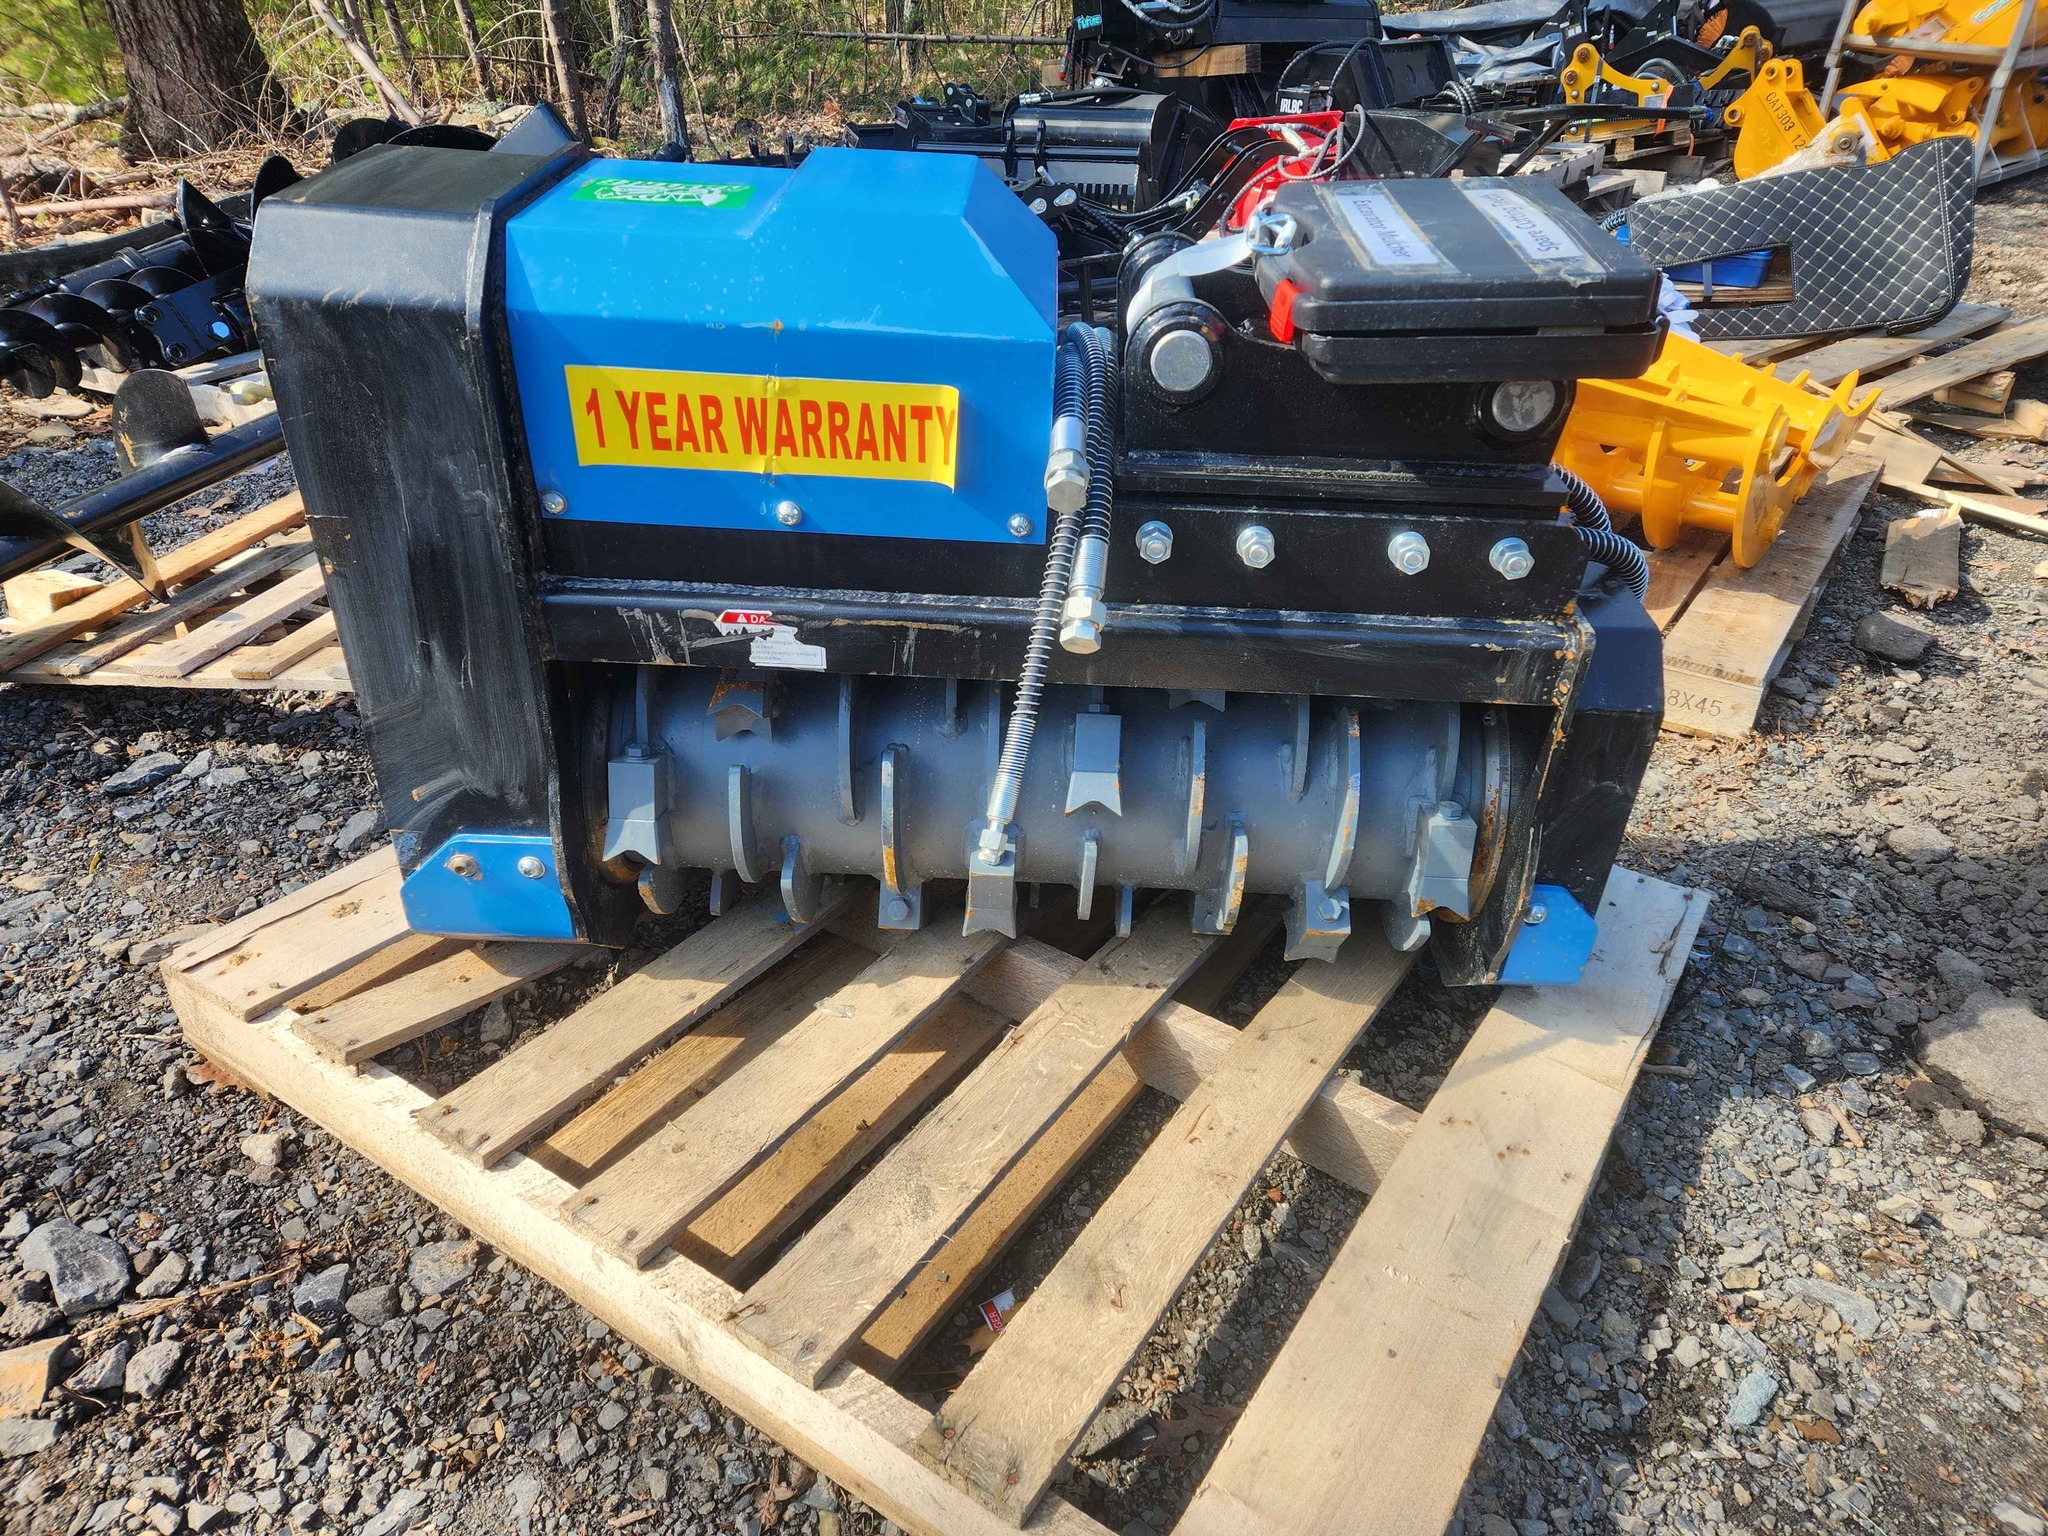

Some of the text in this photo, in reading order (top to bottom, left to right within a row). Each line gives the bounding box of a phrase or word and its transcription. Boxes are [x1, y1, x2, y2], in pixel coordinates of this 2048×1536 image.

[1766, 91, 1796, 132] CAT303
[1353, 199, 1412, 258] Excavator Mulcher
[1503, 205, 1537, 231] Cutting
[1527, 229, 1560, 252] Spare
[585, 387, 956, 466] 1 YEAR WARRANTY
